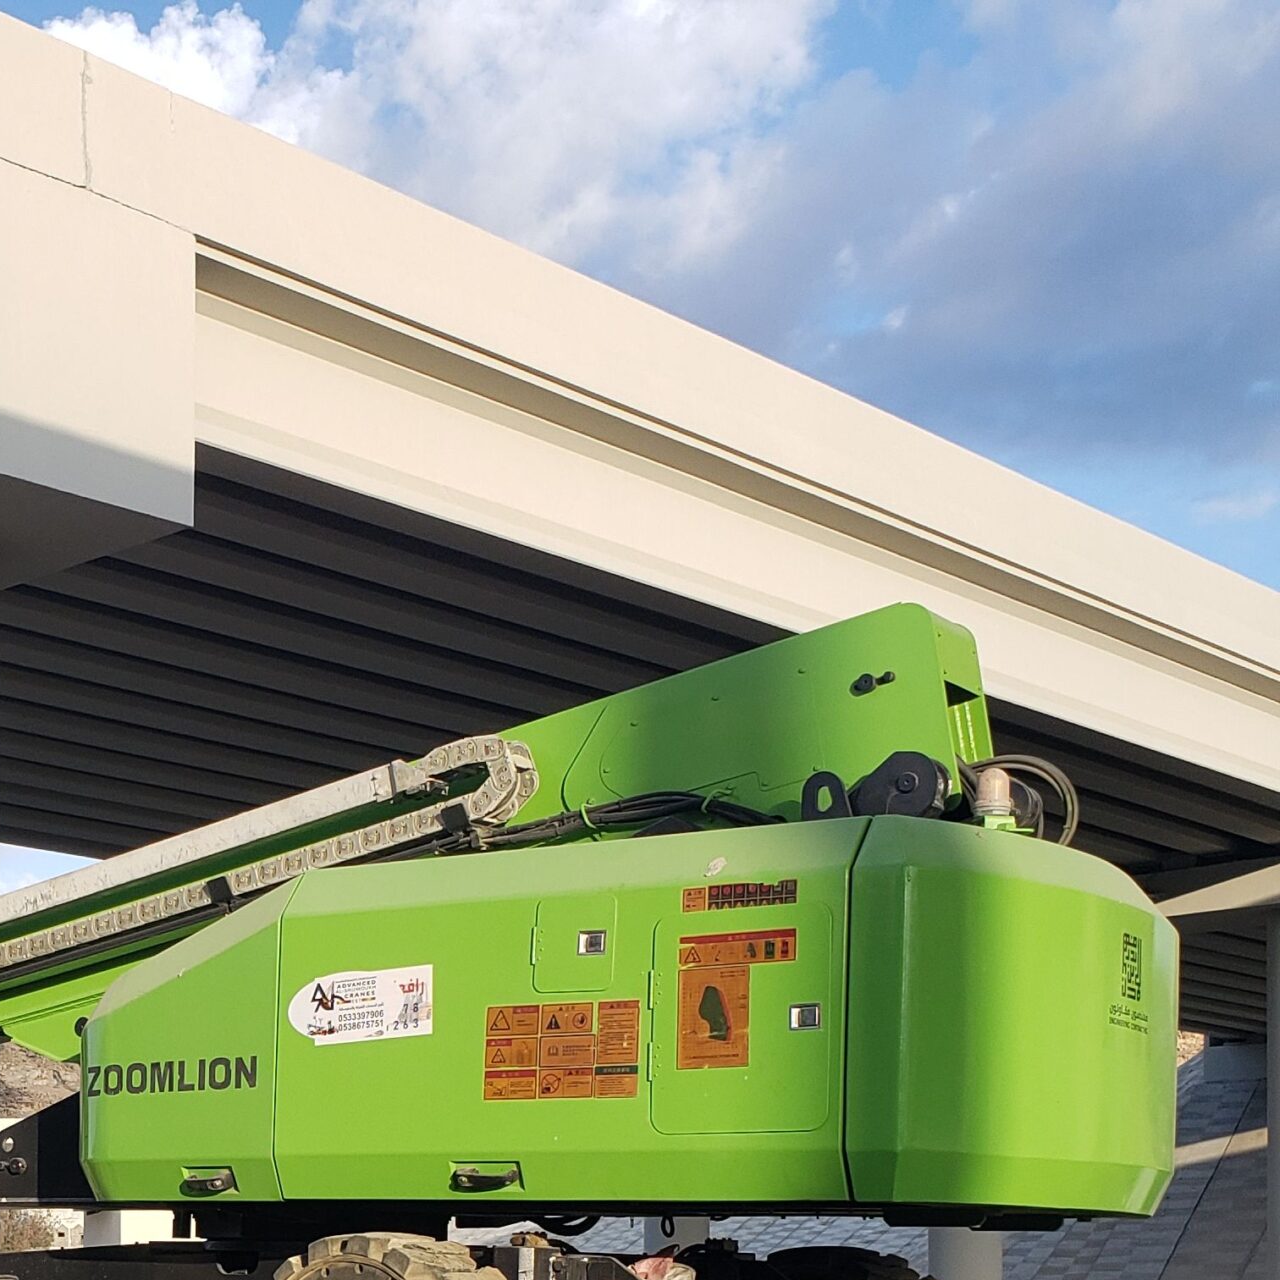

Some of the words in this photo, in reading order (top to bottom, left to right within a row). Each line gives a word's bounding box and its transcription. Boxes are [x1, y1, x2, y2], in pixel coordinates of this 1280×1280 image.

[337, 980, 376, 989] ADVANCED
[344, 990, 375, 999] CRANES
[338, 1009, 384, 1022] 0533397906
[338, 1019, 384, 1032] 0538675751
[87, 1055, 258, 1098] ZOOMLION
